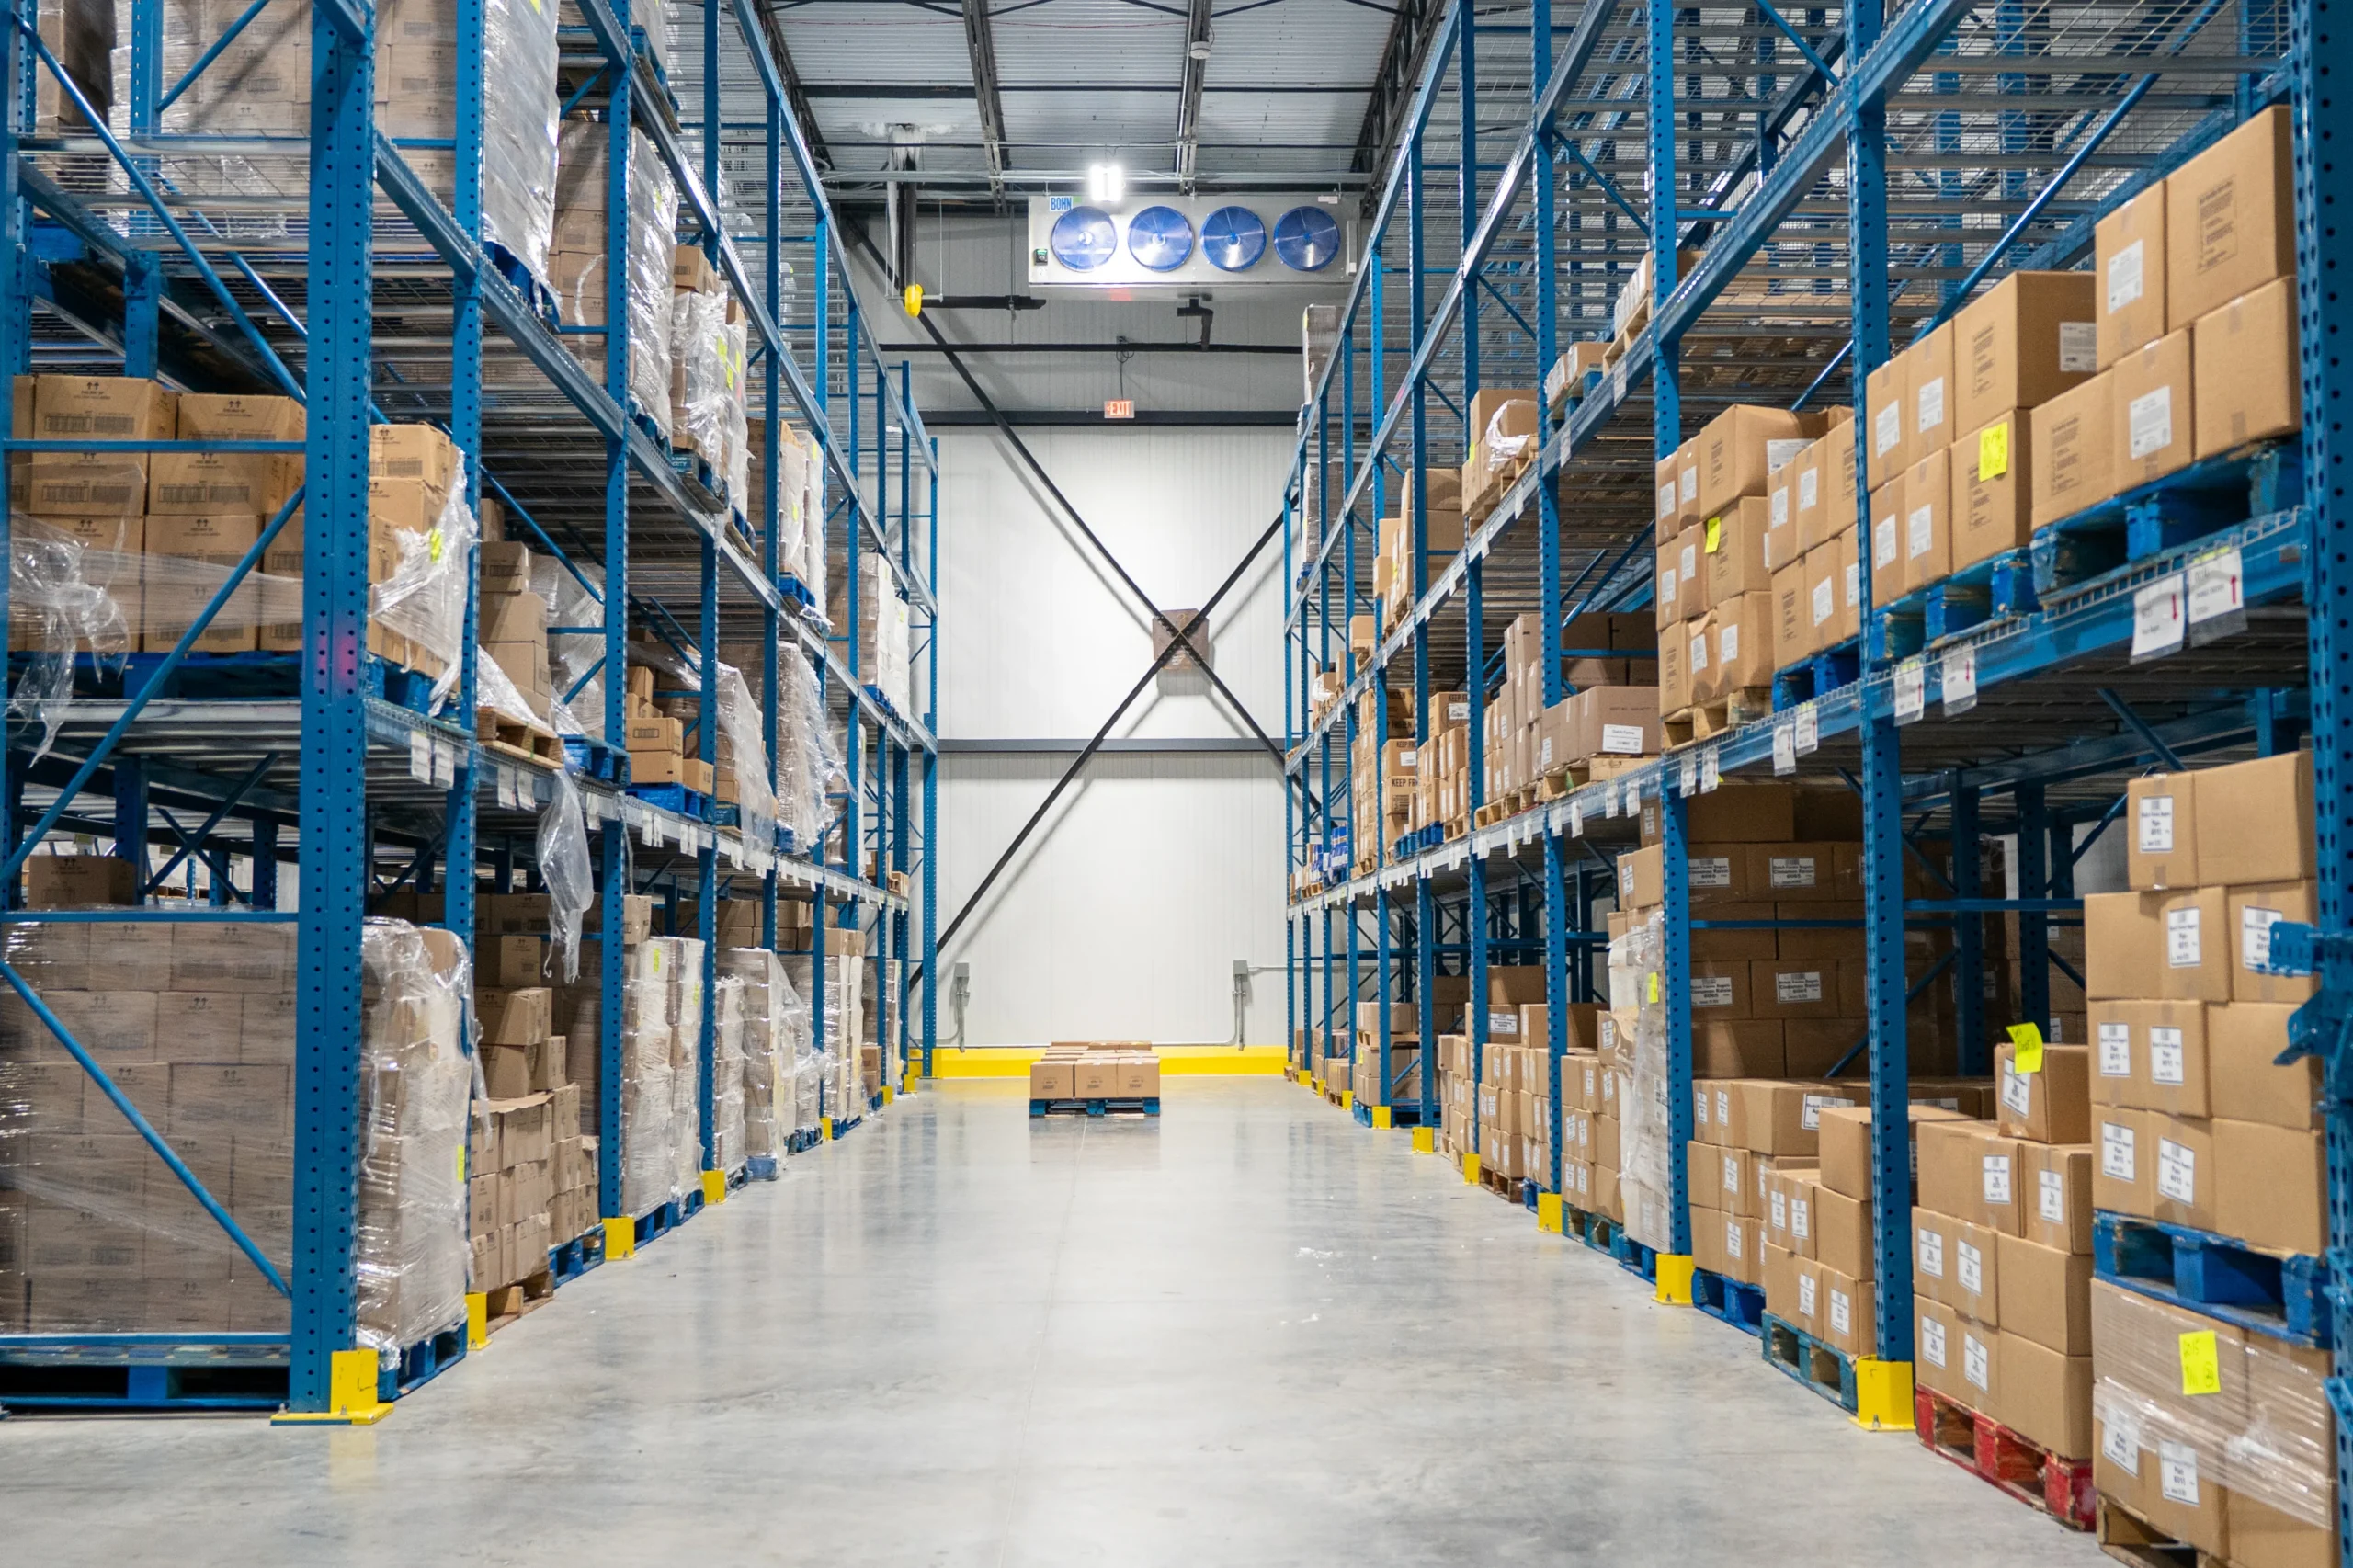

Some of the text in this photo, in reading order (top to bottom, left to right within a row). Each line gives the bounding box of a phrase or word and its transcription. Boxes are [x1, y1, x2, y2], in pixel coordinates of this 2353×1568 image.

[1051, 197, 1072, 210] BOHN
[1110, 401, 1131, 416] EXIT
[1392, 779, 1406, 787] KEEP
